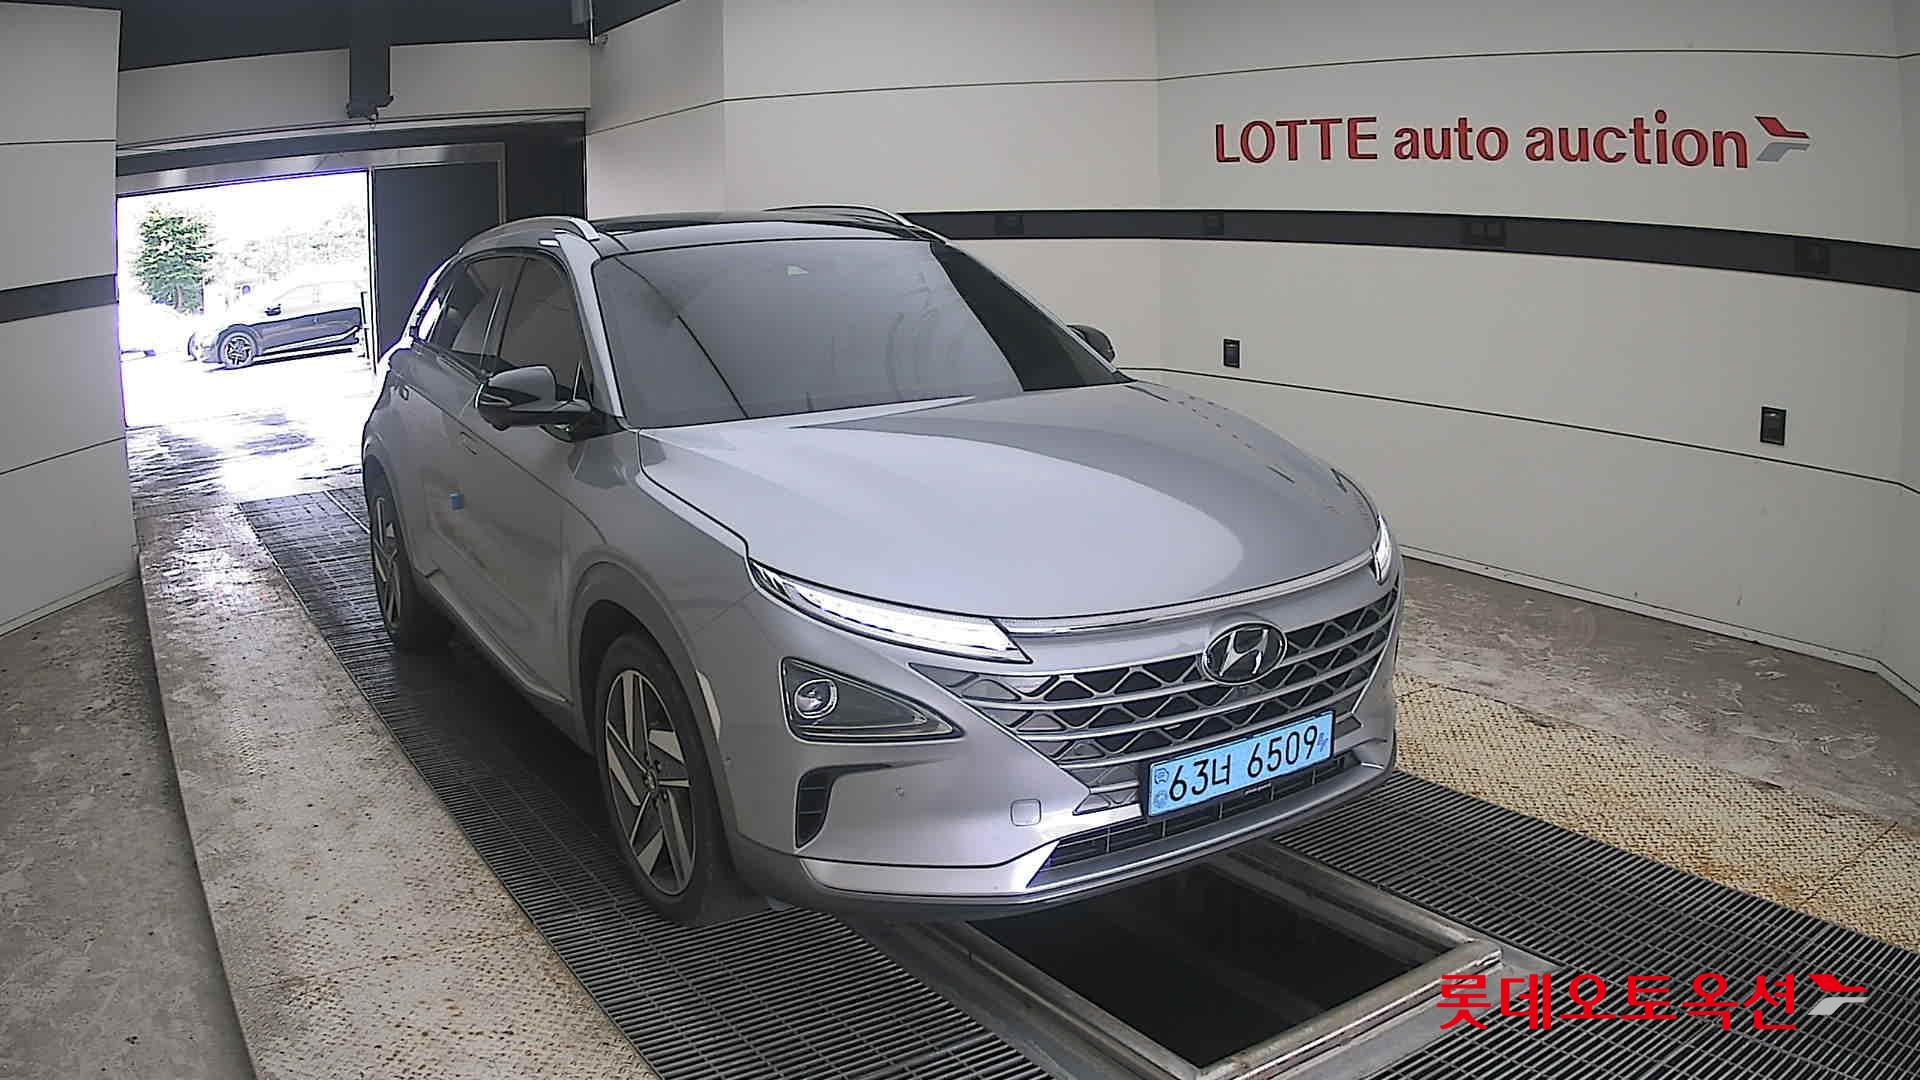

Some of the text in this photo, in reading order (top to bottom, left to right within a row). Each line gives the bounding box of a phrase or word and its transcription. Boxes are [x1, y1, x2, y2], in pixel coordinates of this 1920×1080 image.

[1215, 110, 1749, 169] LOTTE auto auction
[1169, 754, 1231, 801] 63너
[1247, 726, 1318, 778] 6509
